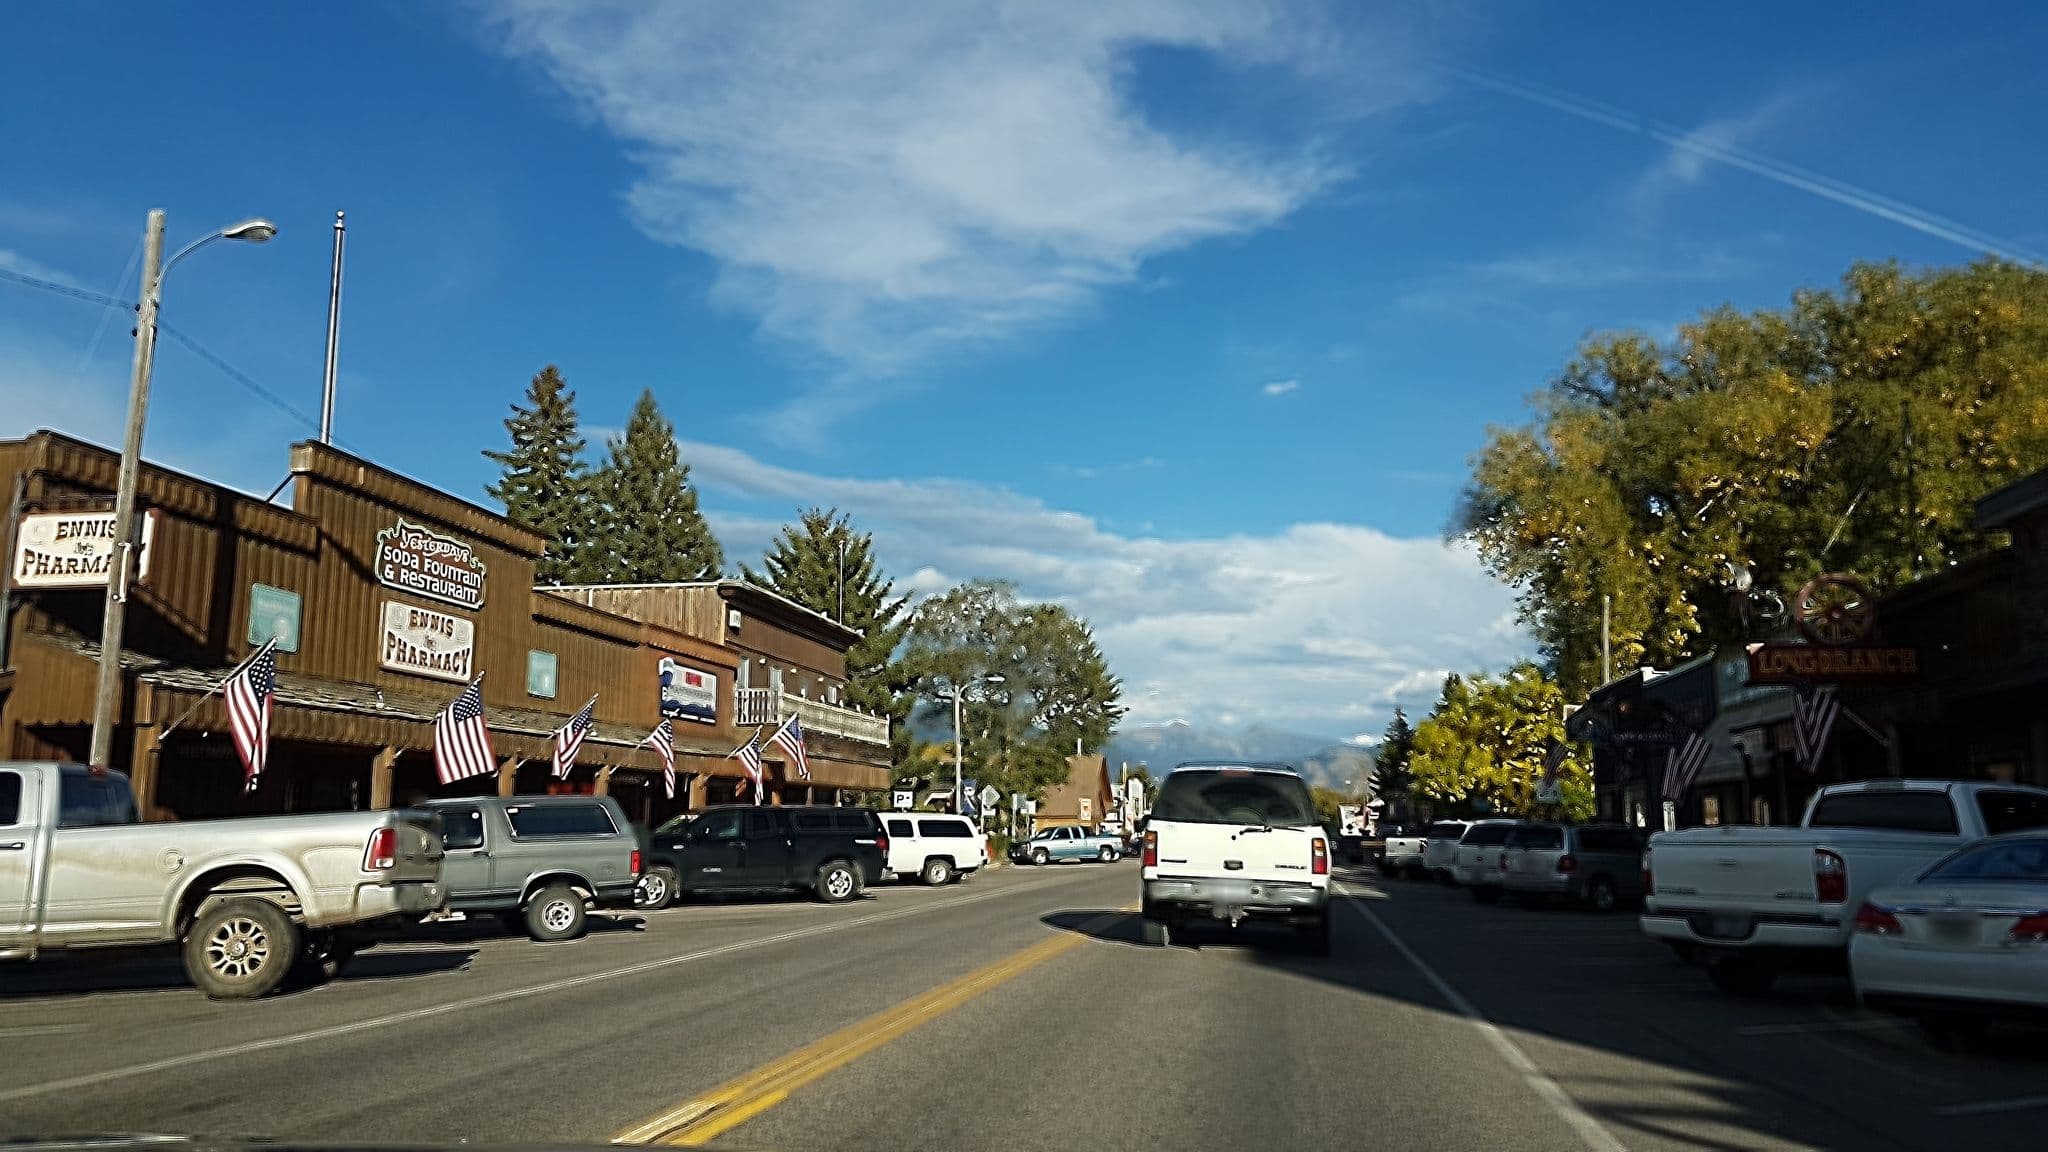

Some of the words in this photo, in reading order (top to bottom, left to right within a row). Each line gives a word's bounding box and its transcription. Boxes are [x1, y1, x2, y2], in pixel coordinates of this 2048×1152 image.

[55, 520, 117, 541] ENNIS
[384, 546, 419, 570] SODA
[424, 557, 481, 588] FOUNTAIN
[384, 565, 394, 580] &
[400, 569, 477, 603] RESTAURANT
[408, 609, 454, 637] ENNIS
[386, 631, 470, 676] PHARMACY
